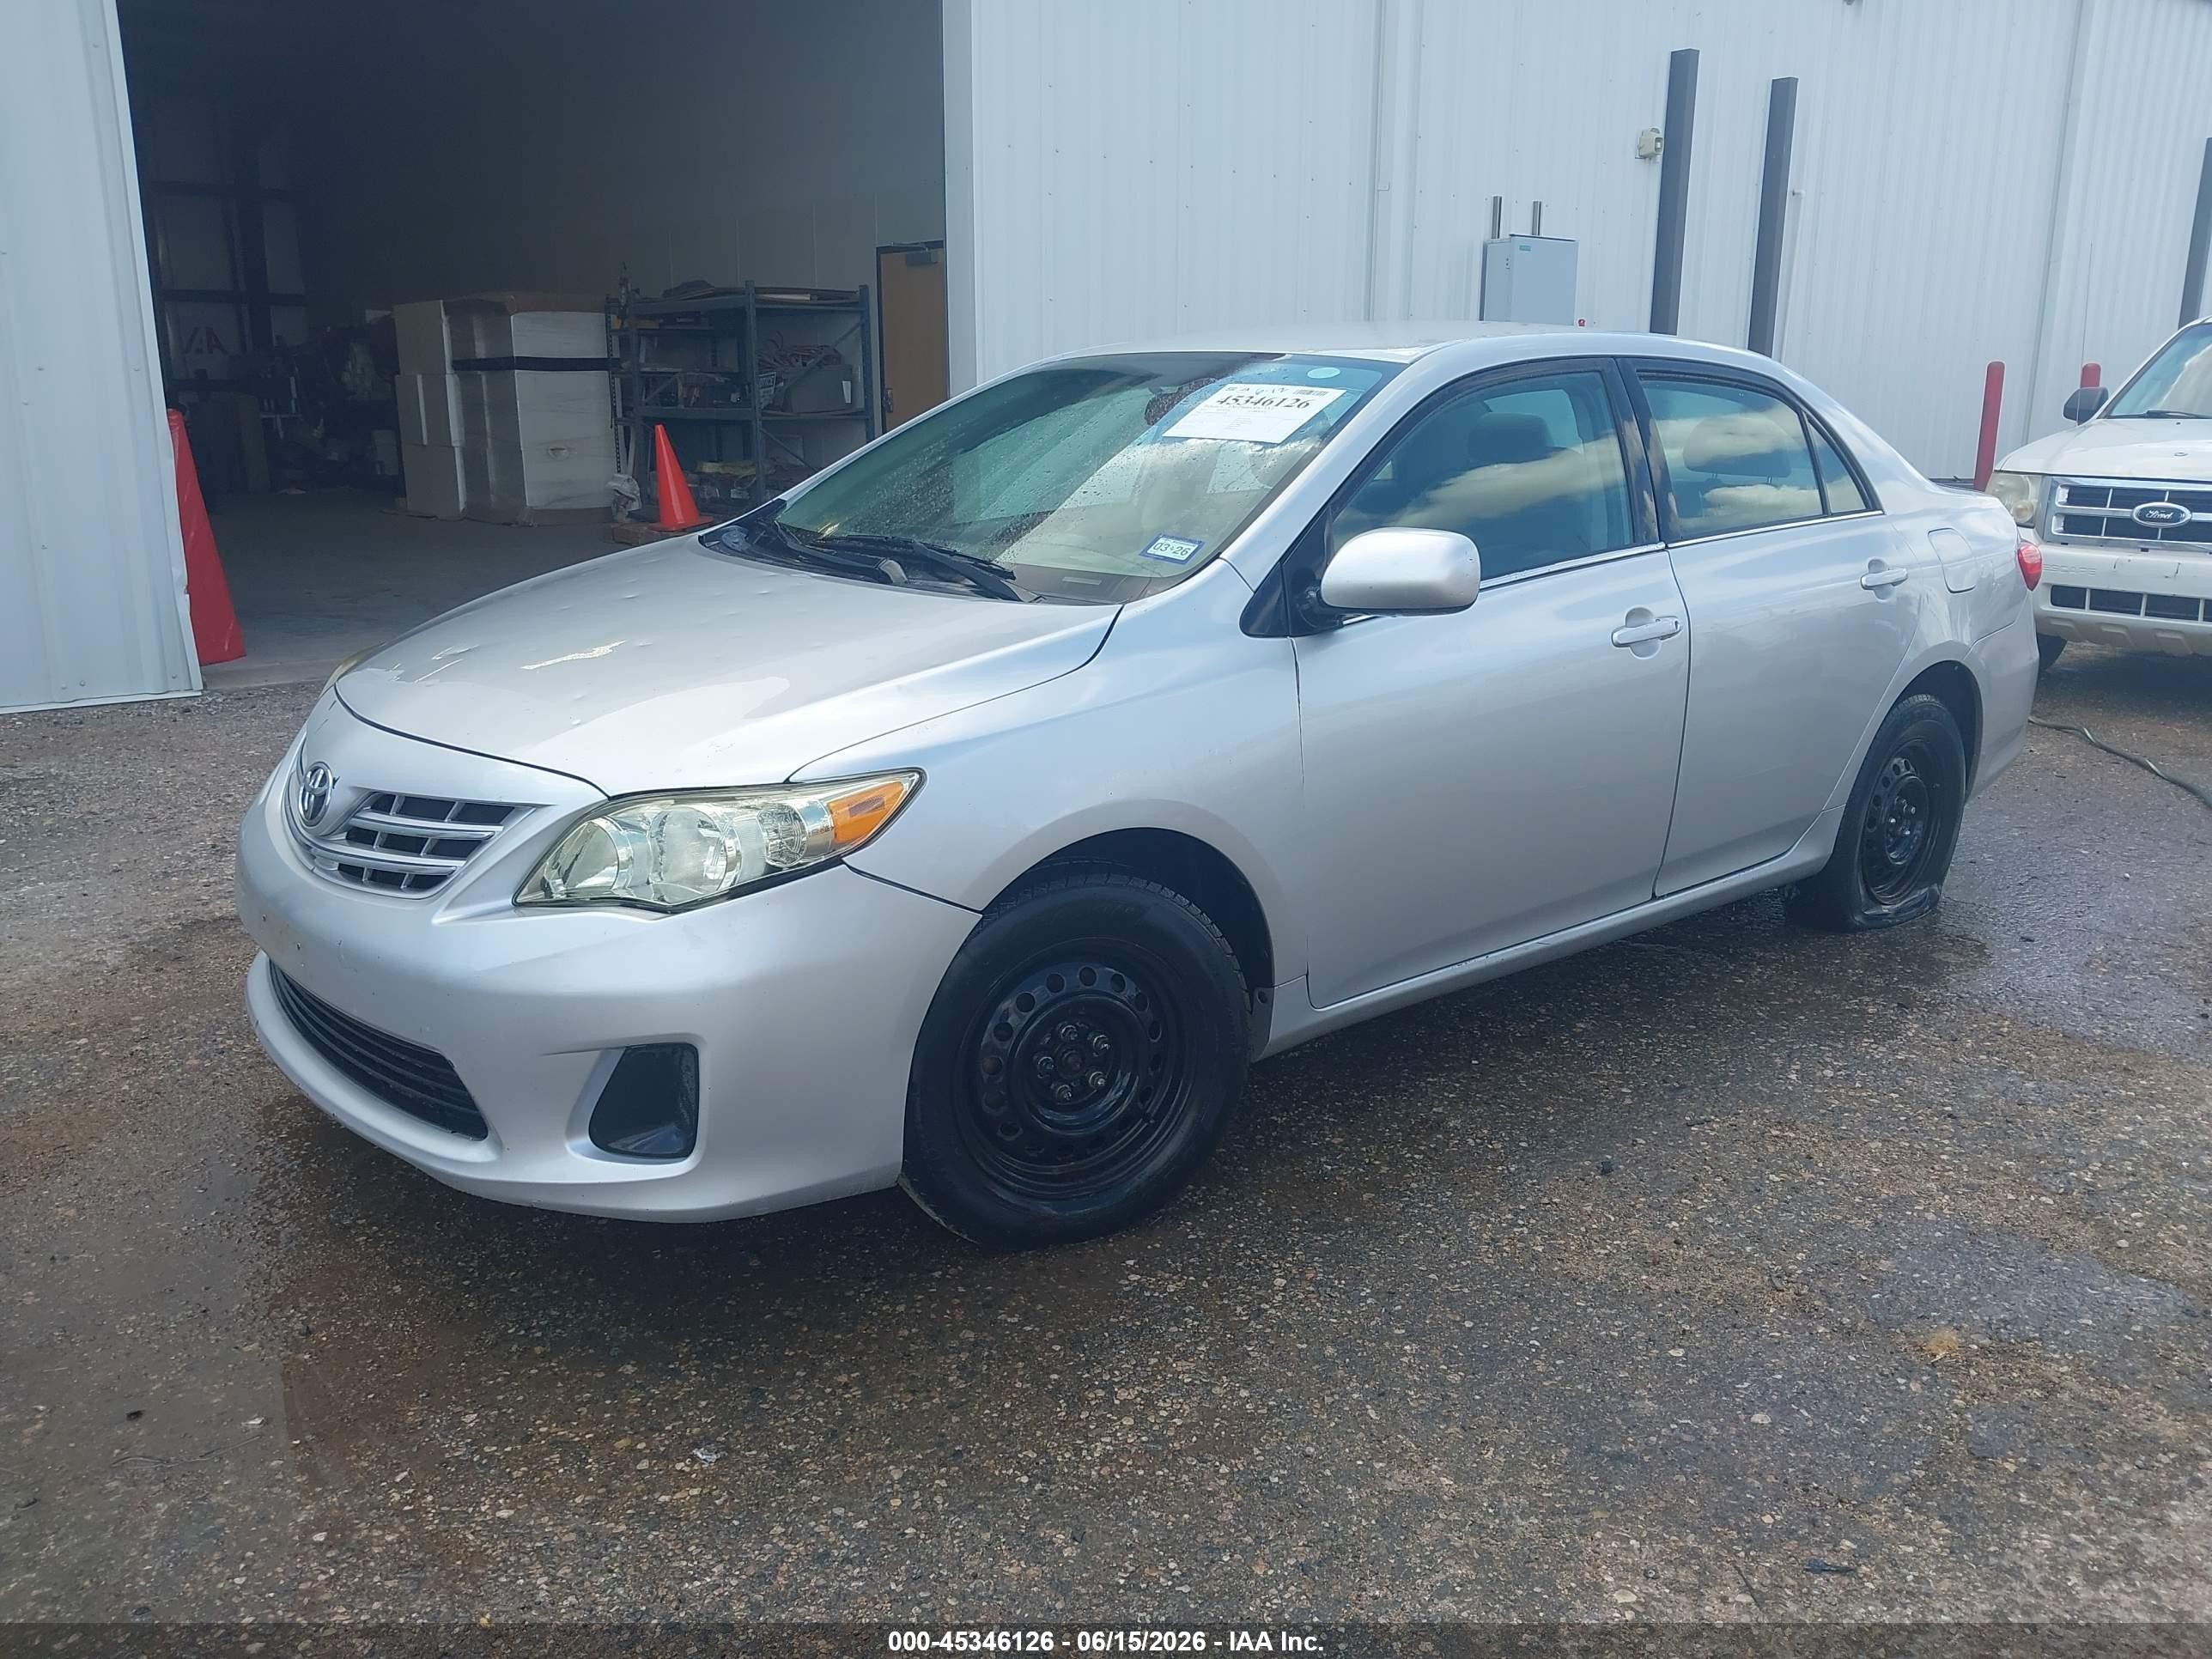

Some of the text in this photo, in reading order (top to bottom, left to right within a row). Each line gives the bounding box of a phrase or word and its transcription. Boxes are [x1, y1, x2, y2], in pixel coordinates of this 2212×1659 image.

[1216, 395, 1316, 409] 45346126
[2145, 510, 2173, 520] Ford
[1153, 542, 1170, 552] 03
[1172, 545, 1191, 556] 26
